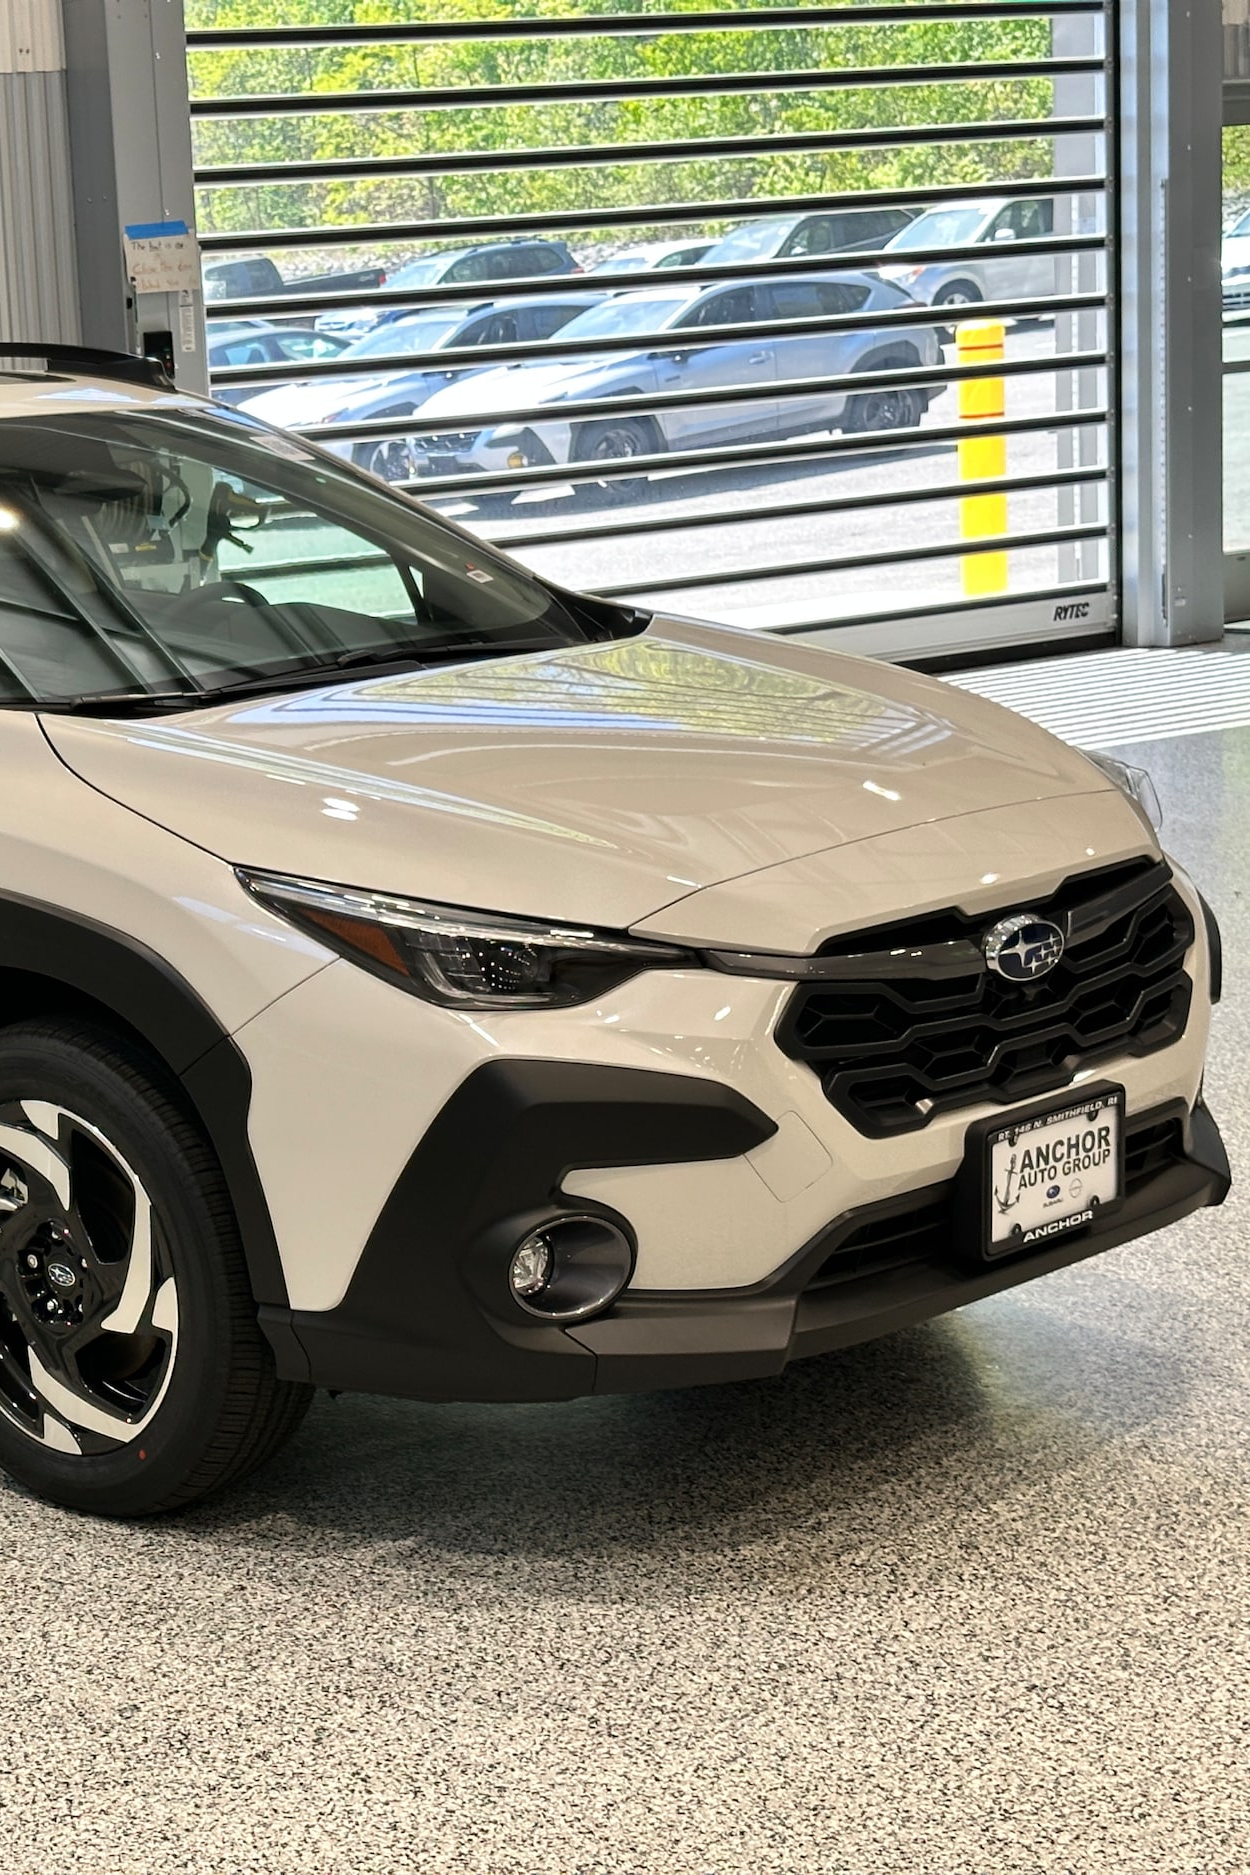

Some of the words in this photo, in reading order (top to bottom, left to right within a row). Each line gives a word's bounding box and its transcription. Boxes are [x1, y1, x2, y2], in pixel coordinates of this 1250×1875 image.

[1053, 602, 1090, 621] RYTEC
[1107, 1096, 1117, 1106] RI
[1020, 1125, 1111, 1173] ANCHOR
[1018, 1165, 1057, 1191] AUTO
[1062, 1148, 1111, 1176] GROUP
[1023, 1210, 1094, 1243] ANCHOR
